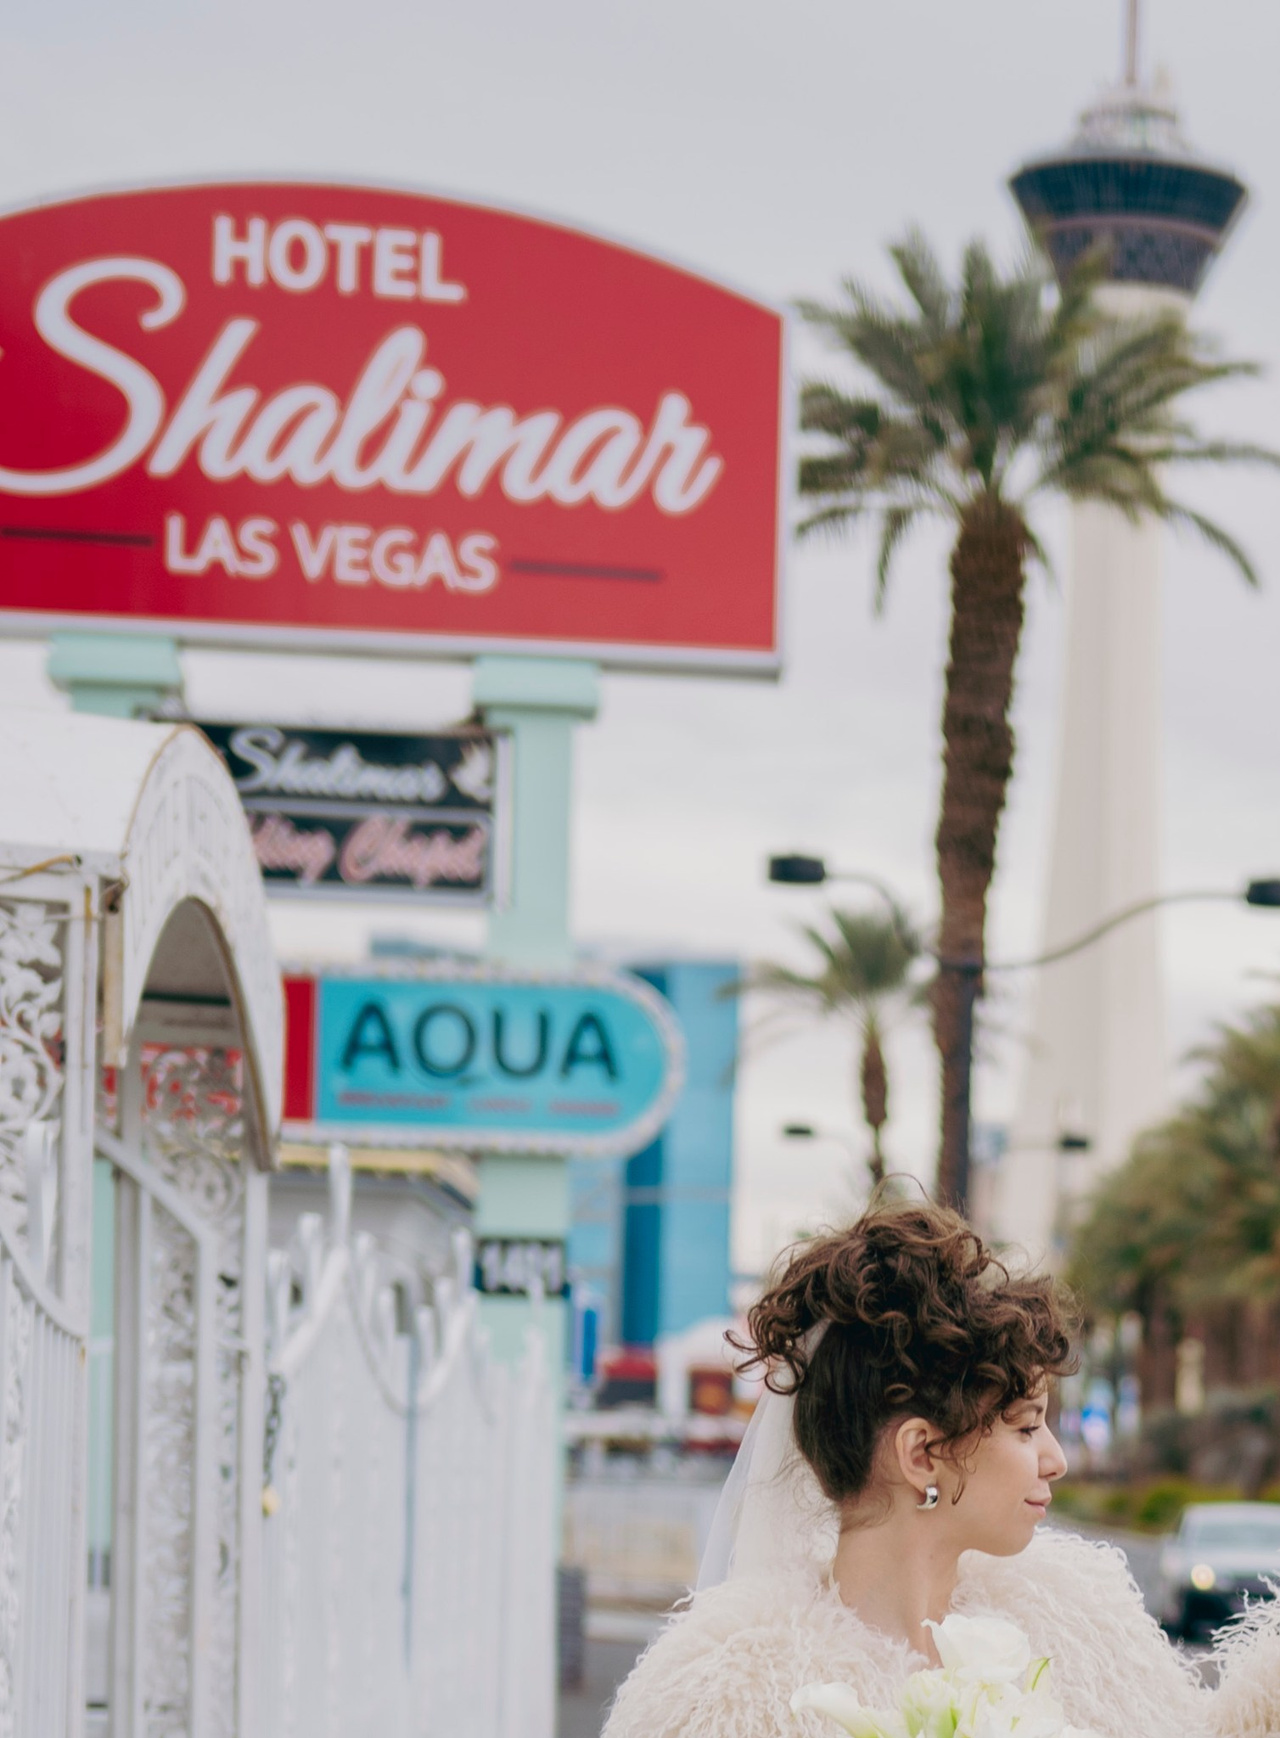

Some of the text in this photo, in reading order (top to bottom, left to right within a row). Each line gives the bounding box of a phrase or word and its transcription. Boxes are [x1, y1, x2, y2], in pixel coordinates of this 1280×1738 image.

[212, 214, 466, 302] HOTEL
[0, 256, 723, 512] Shalimar
[165, 514, 498, 593] LAS VEGAS
[228, 727, 447, 802] Shalimar
[339, 1001, 619, 1085] AQUA
